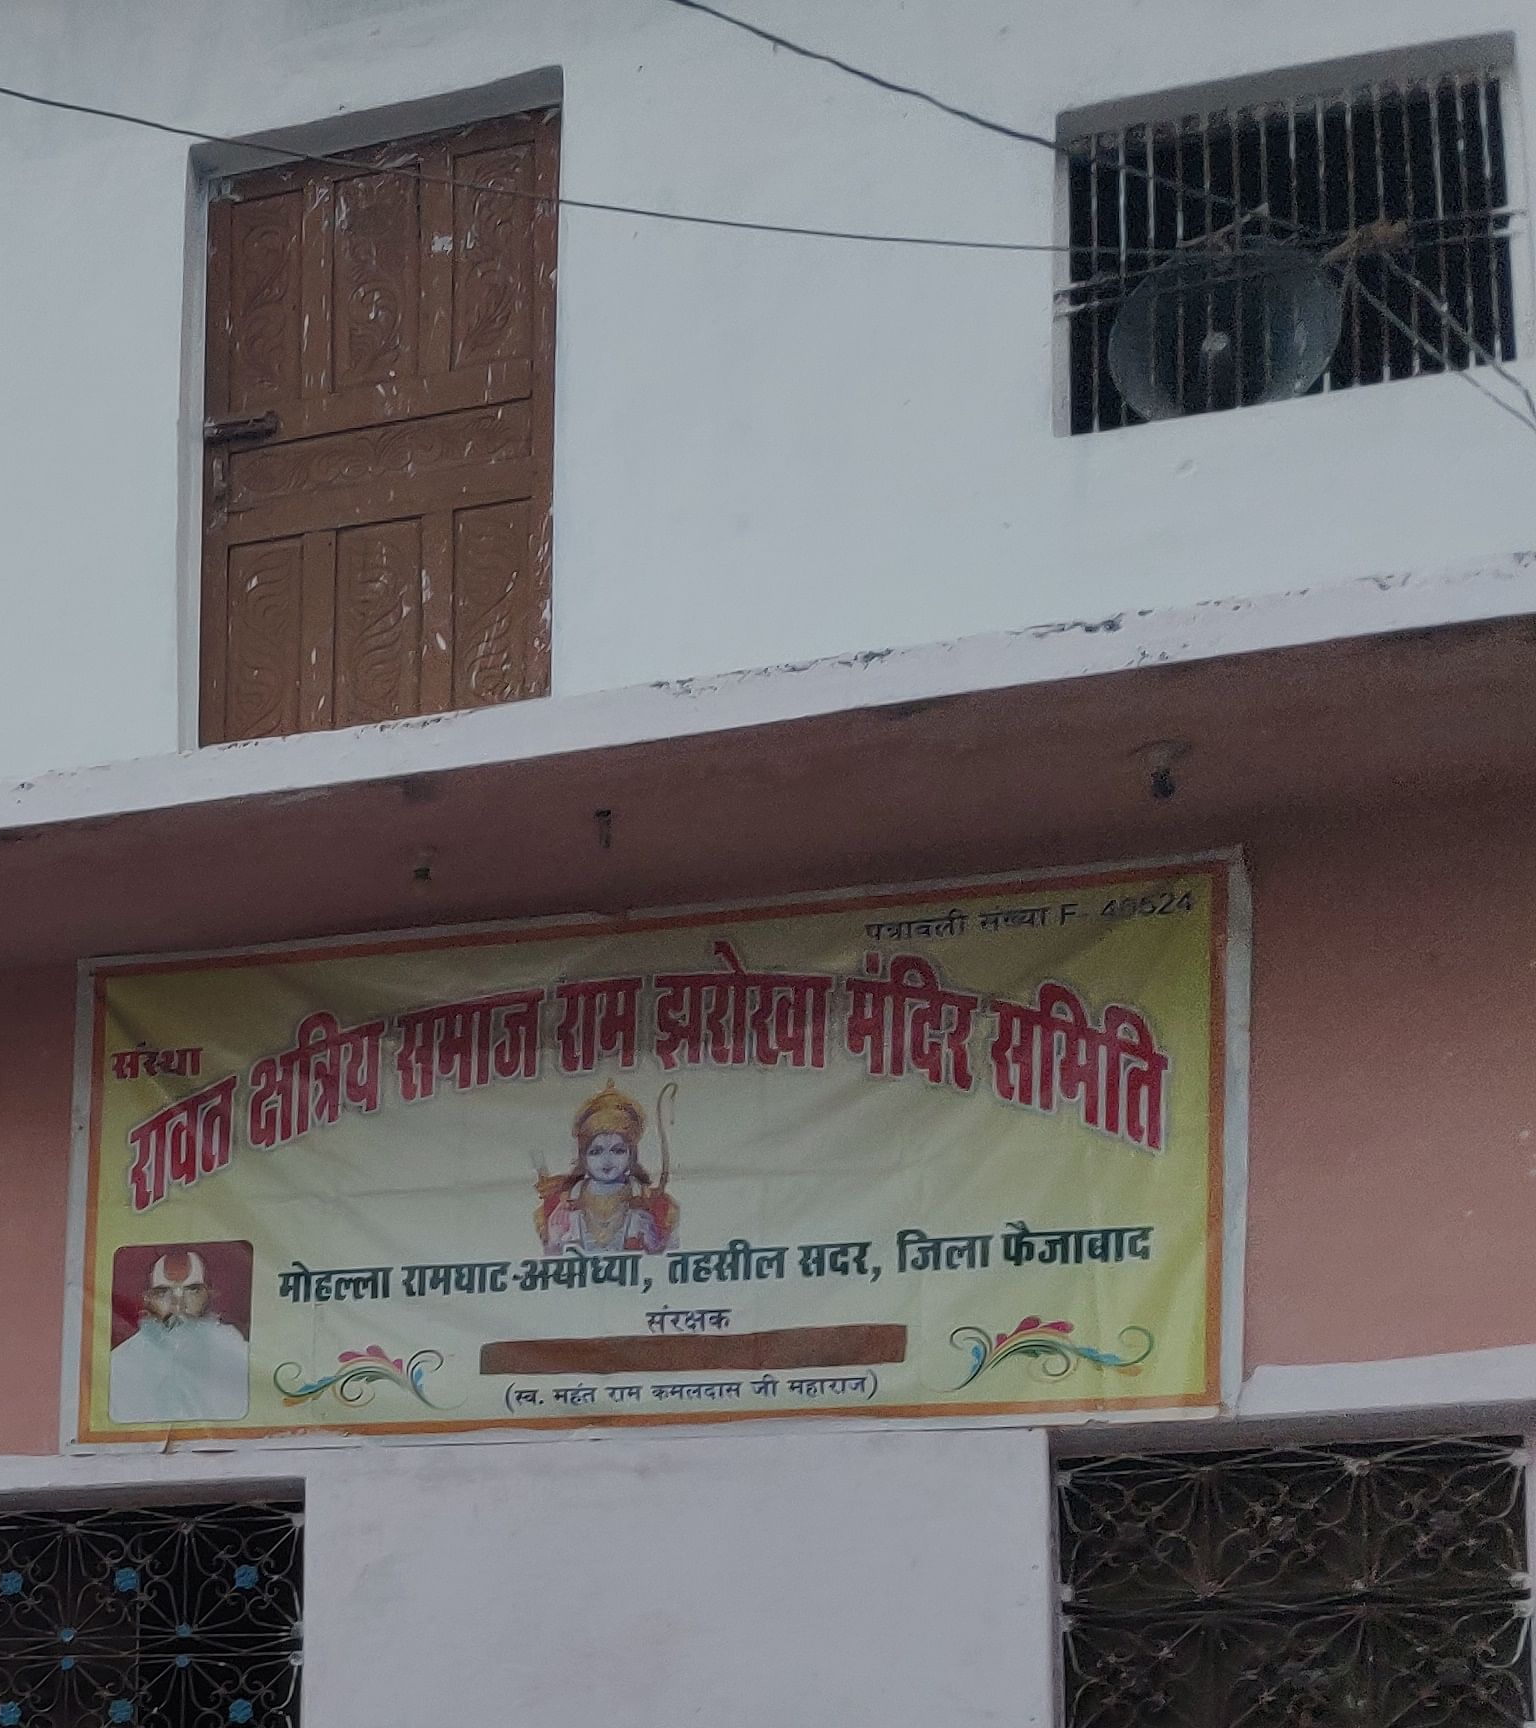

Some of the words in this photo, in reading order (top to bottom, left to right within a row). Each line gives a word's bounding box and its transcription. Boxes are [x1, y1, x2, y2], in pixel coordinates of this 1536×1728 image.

[110, 1040, 203, 1080] संस्था
[129, 1074, 238, 1212] रावत
[249, 1010, 386, 1149] क्षत्रिय
[395, 989, 546, 1102] समाज
[556, 976, 644, 1073] राम
[654, 940, 833, 1071] झरोखा
[846, 952, 980, 1091] मंदिर
[989, 980, 1170, 1151] समिति
[277, 1260, 394, 1304] मोहल्ला
[666, 1238, 789, 1285] तहसील
[797, 1240, 882, 1283] सदर,
[896, 1229, 995, 1274] जिला
[1001, 1220, 1156, 1268] फैजाबाद
[645, 1304, 732, 1334] संरक्षक
[551, 1382, 597, 1405] महंत
[608, 1384, 642, 1404] राम
[650, 1381, 740, 1402] कमलदास
[749, 1374, 779, 1398] जी
[785, 1370, 879, 1401] महाराज)
